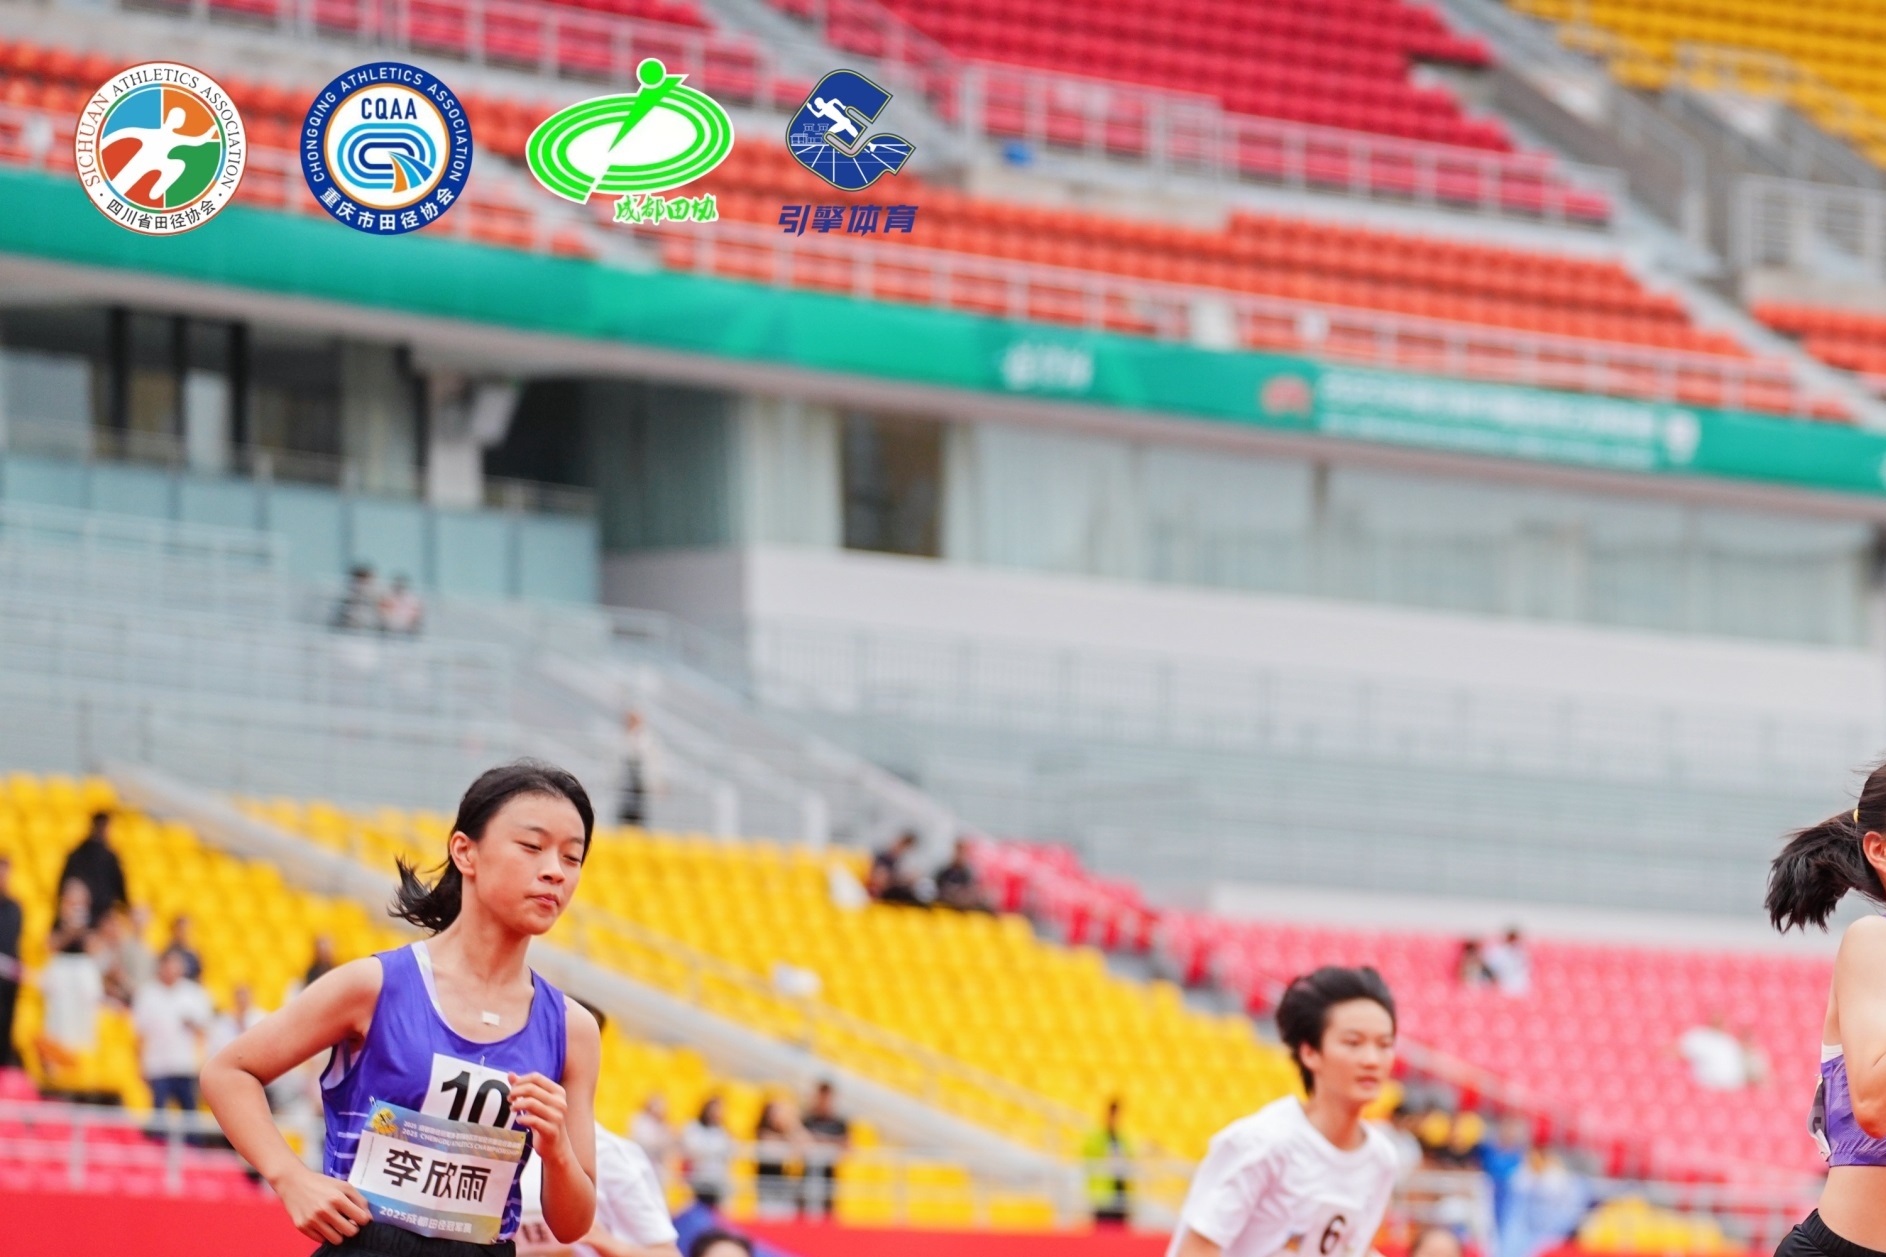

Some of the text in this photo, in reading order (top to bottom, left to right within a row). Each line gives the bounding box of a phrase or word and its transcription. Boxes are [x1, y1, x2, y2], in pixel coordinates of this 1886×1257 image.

[440, 1070, 512, 1130] 10
[383, 1148, 491, 1203] 李欣雨
[1319, 1214, 1346, 1256] 6
